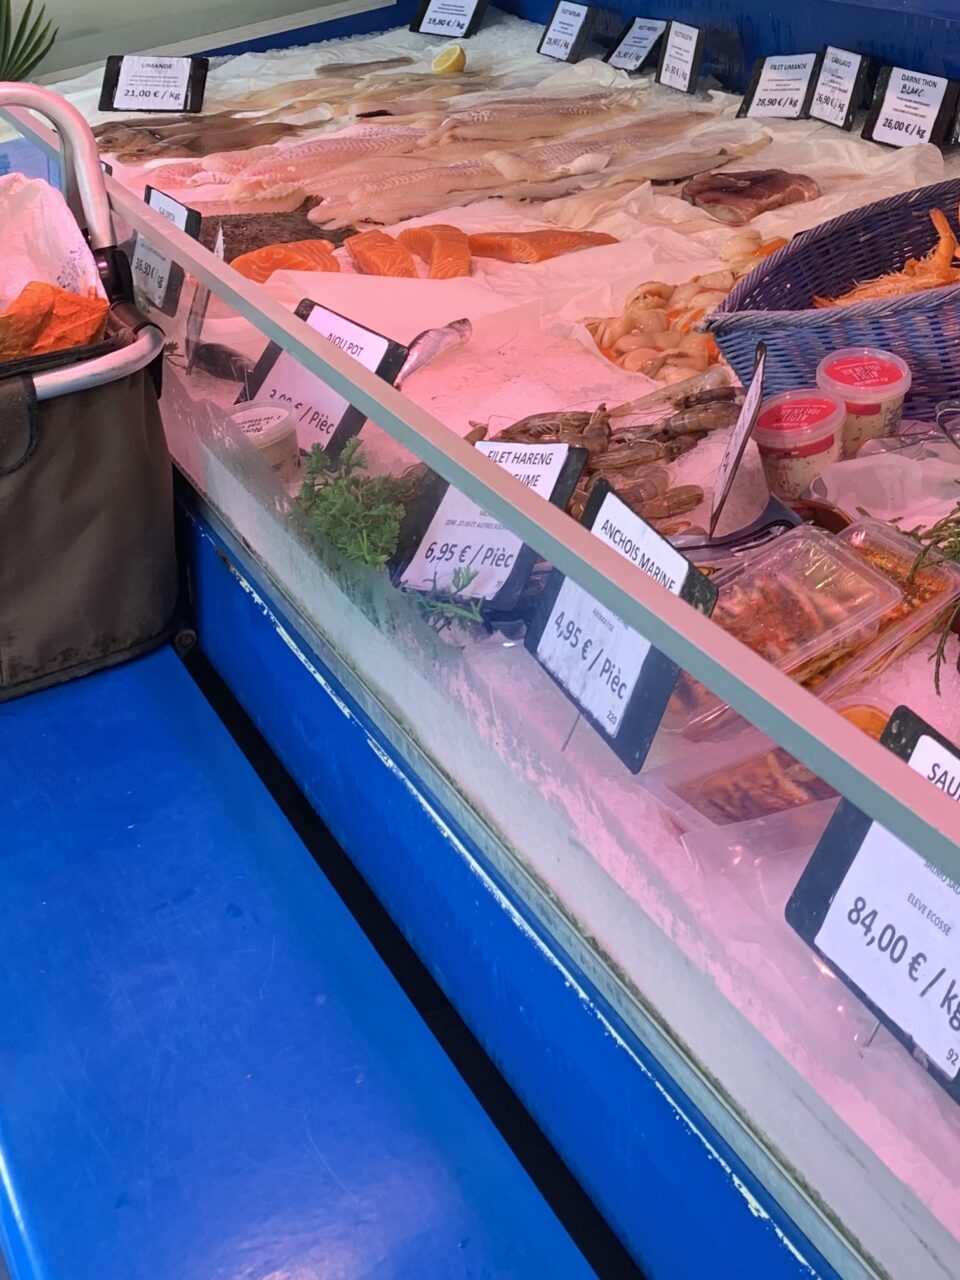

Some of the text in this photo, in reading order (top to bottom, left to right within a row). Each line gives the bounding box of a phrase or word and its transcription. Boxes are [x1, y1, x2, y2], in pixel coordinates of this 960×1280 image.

[456, 21, 465, 29] kg
[901, 74, 937, 88] DARNE THON
[124, 89, 150, 98] 21,00
[153, 90, 160, 98] €
[169, 91, 181, 100] kg
[789, 97, 798, 108] kg
[882, 118, 904, 131] 26,00
[905, 123, 911, 133] €
[916, 126, 926, 138] kg
[346, 342, 364, 357] POT
[299, 406, 334, 434] / Pièc
[511, 451, 554, 465] HARENG
[600, 519, 640, 562] ANCHOIS
[425, 542, 514, 568] 6,95 € / Pièc
[555, 611, 628, 700] 4,95 € / Pièc
[907, 893, 952, 937] ELEVE ECOSSE
[847, 896, 909, 964] 84,00
[908, 951, 928, 982] €
[919, 967, 946, 998] /
[945, 1048, 960, 1066] 92
